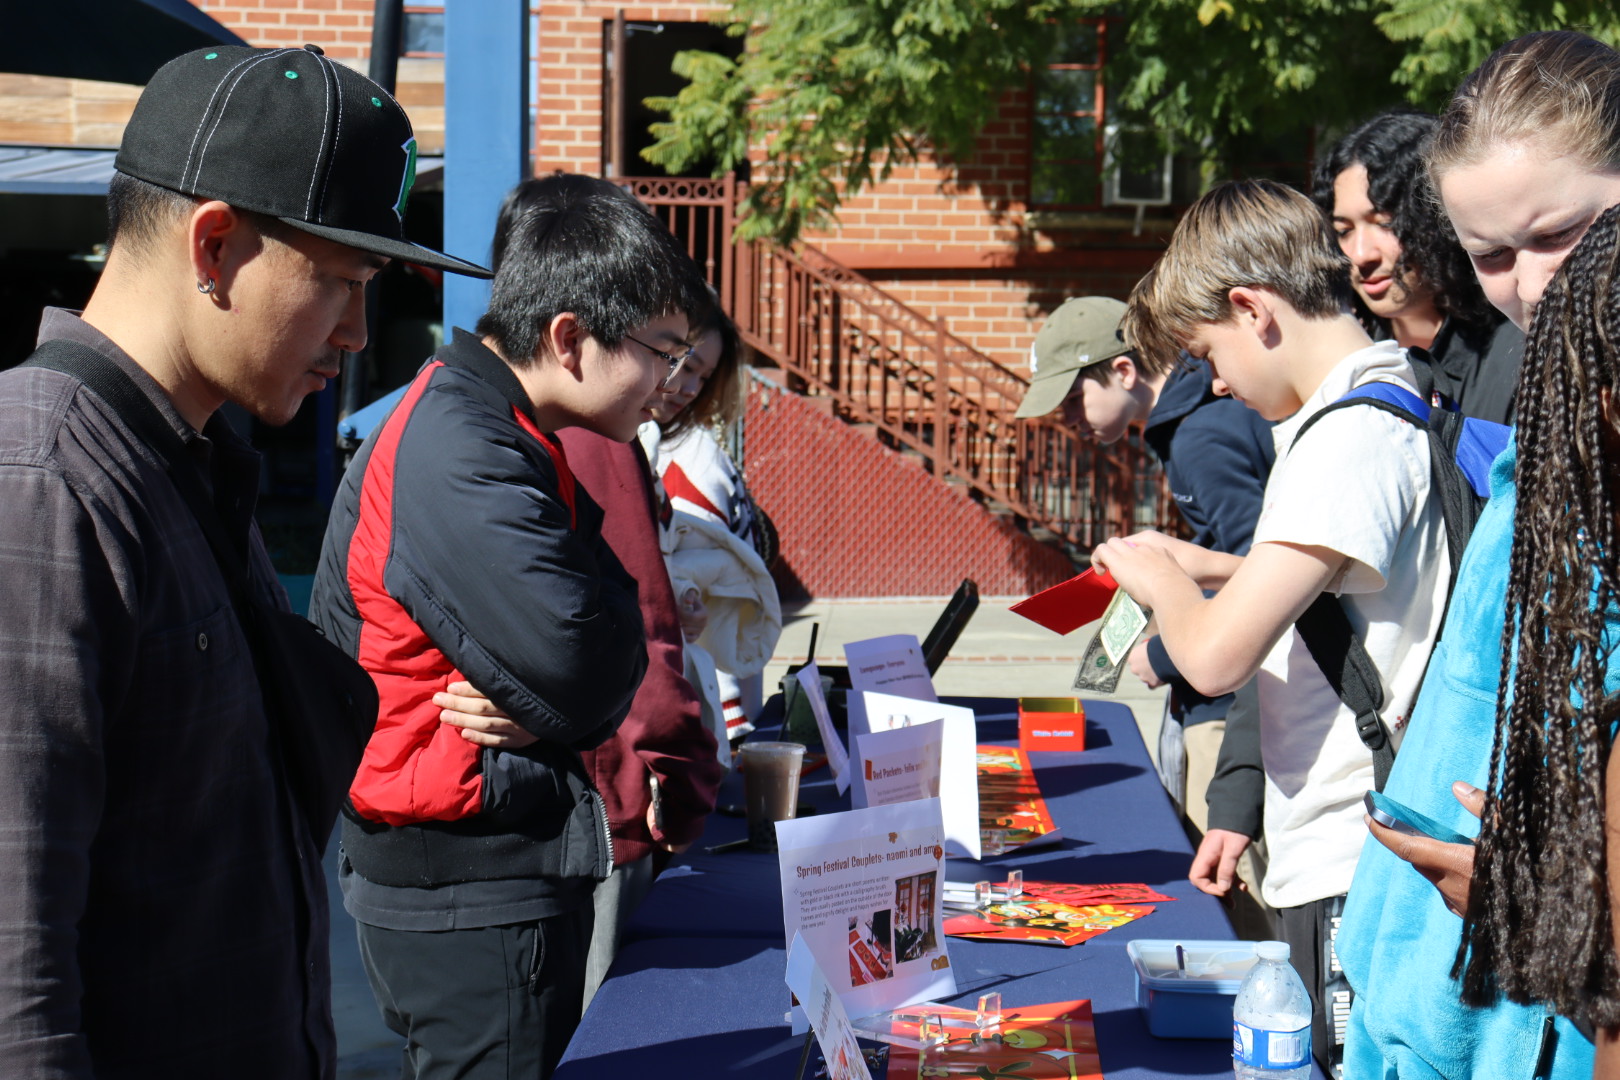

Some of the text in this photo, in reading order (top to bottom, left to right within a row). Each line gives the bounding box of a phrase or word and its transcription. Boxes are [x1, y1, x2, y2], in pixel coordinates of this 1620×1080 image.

[873, 769, 882, 780] Red
[797, 864, 822, 879] Spring
[823, 857, 849, 873] Festival
[851, 853, 884, 868] Couplets-
[886, 847, 908, 861] naomi
[909, 844, 922, 857] and
